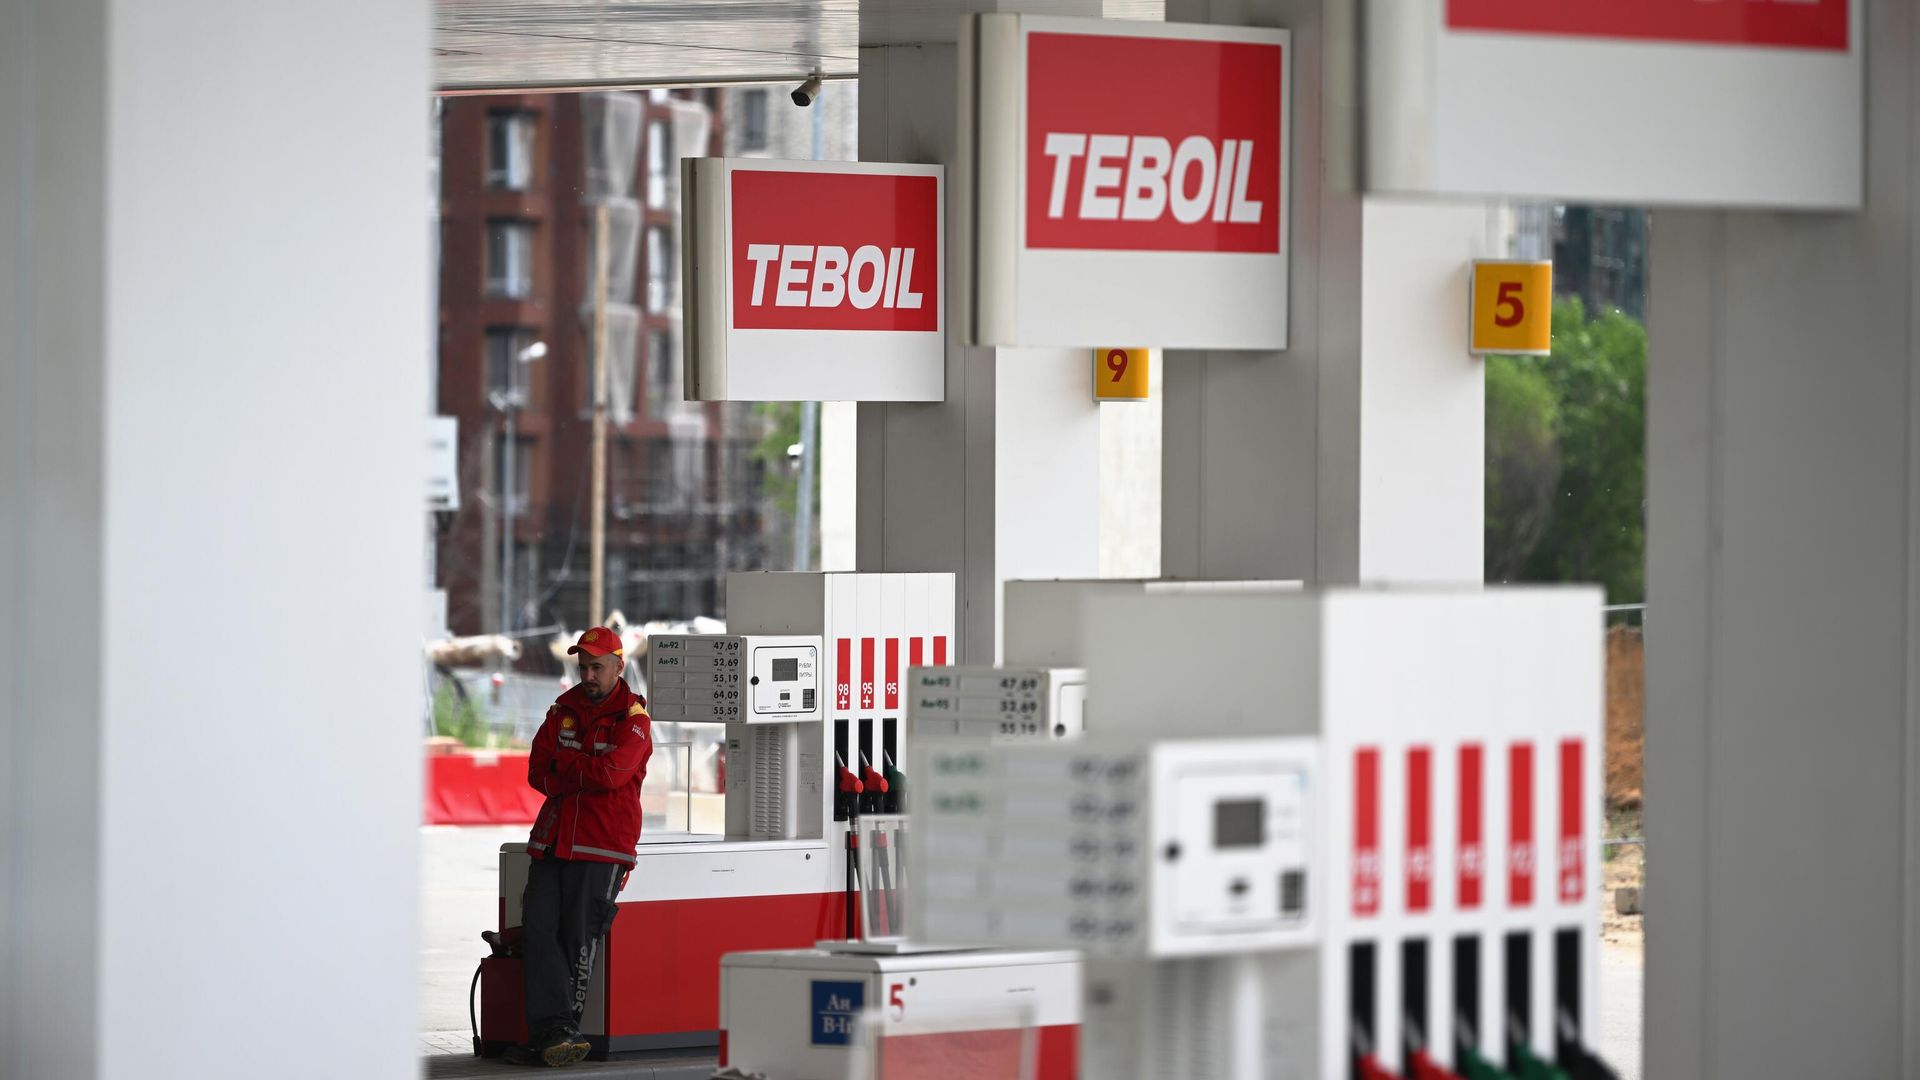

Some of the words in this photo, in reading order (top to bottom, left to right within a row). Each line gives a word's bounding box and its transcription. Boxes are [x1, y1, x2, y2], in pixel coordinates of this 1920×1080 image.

[1044, 132, 1263, 223] TEBOIL
[747, 244, 923, 310] TEBOIL
[1494, 281, 1525, 328] 5
[1107, 348, 1128, 383] 9
[658, 641, 679, 649] Аи-92
[713, 641, 739, 651] 47,69
[713, 657, 739, 667] 52,69
[713, 674, 739, 684] 55,19
[838, 683, 849, 696] 98
[862, 682, 873, 694] 95
[886, 682, 897, 695] 95
[713, 690, 739, 700] 64,09
[713, 706, 739, 716] 55,59
[572, 945, 589, 1013] Service
[889, 984, 904, 1022] 5
